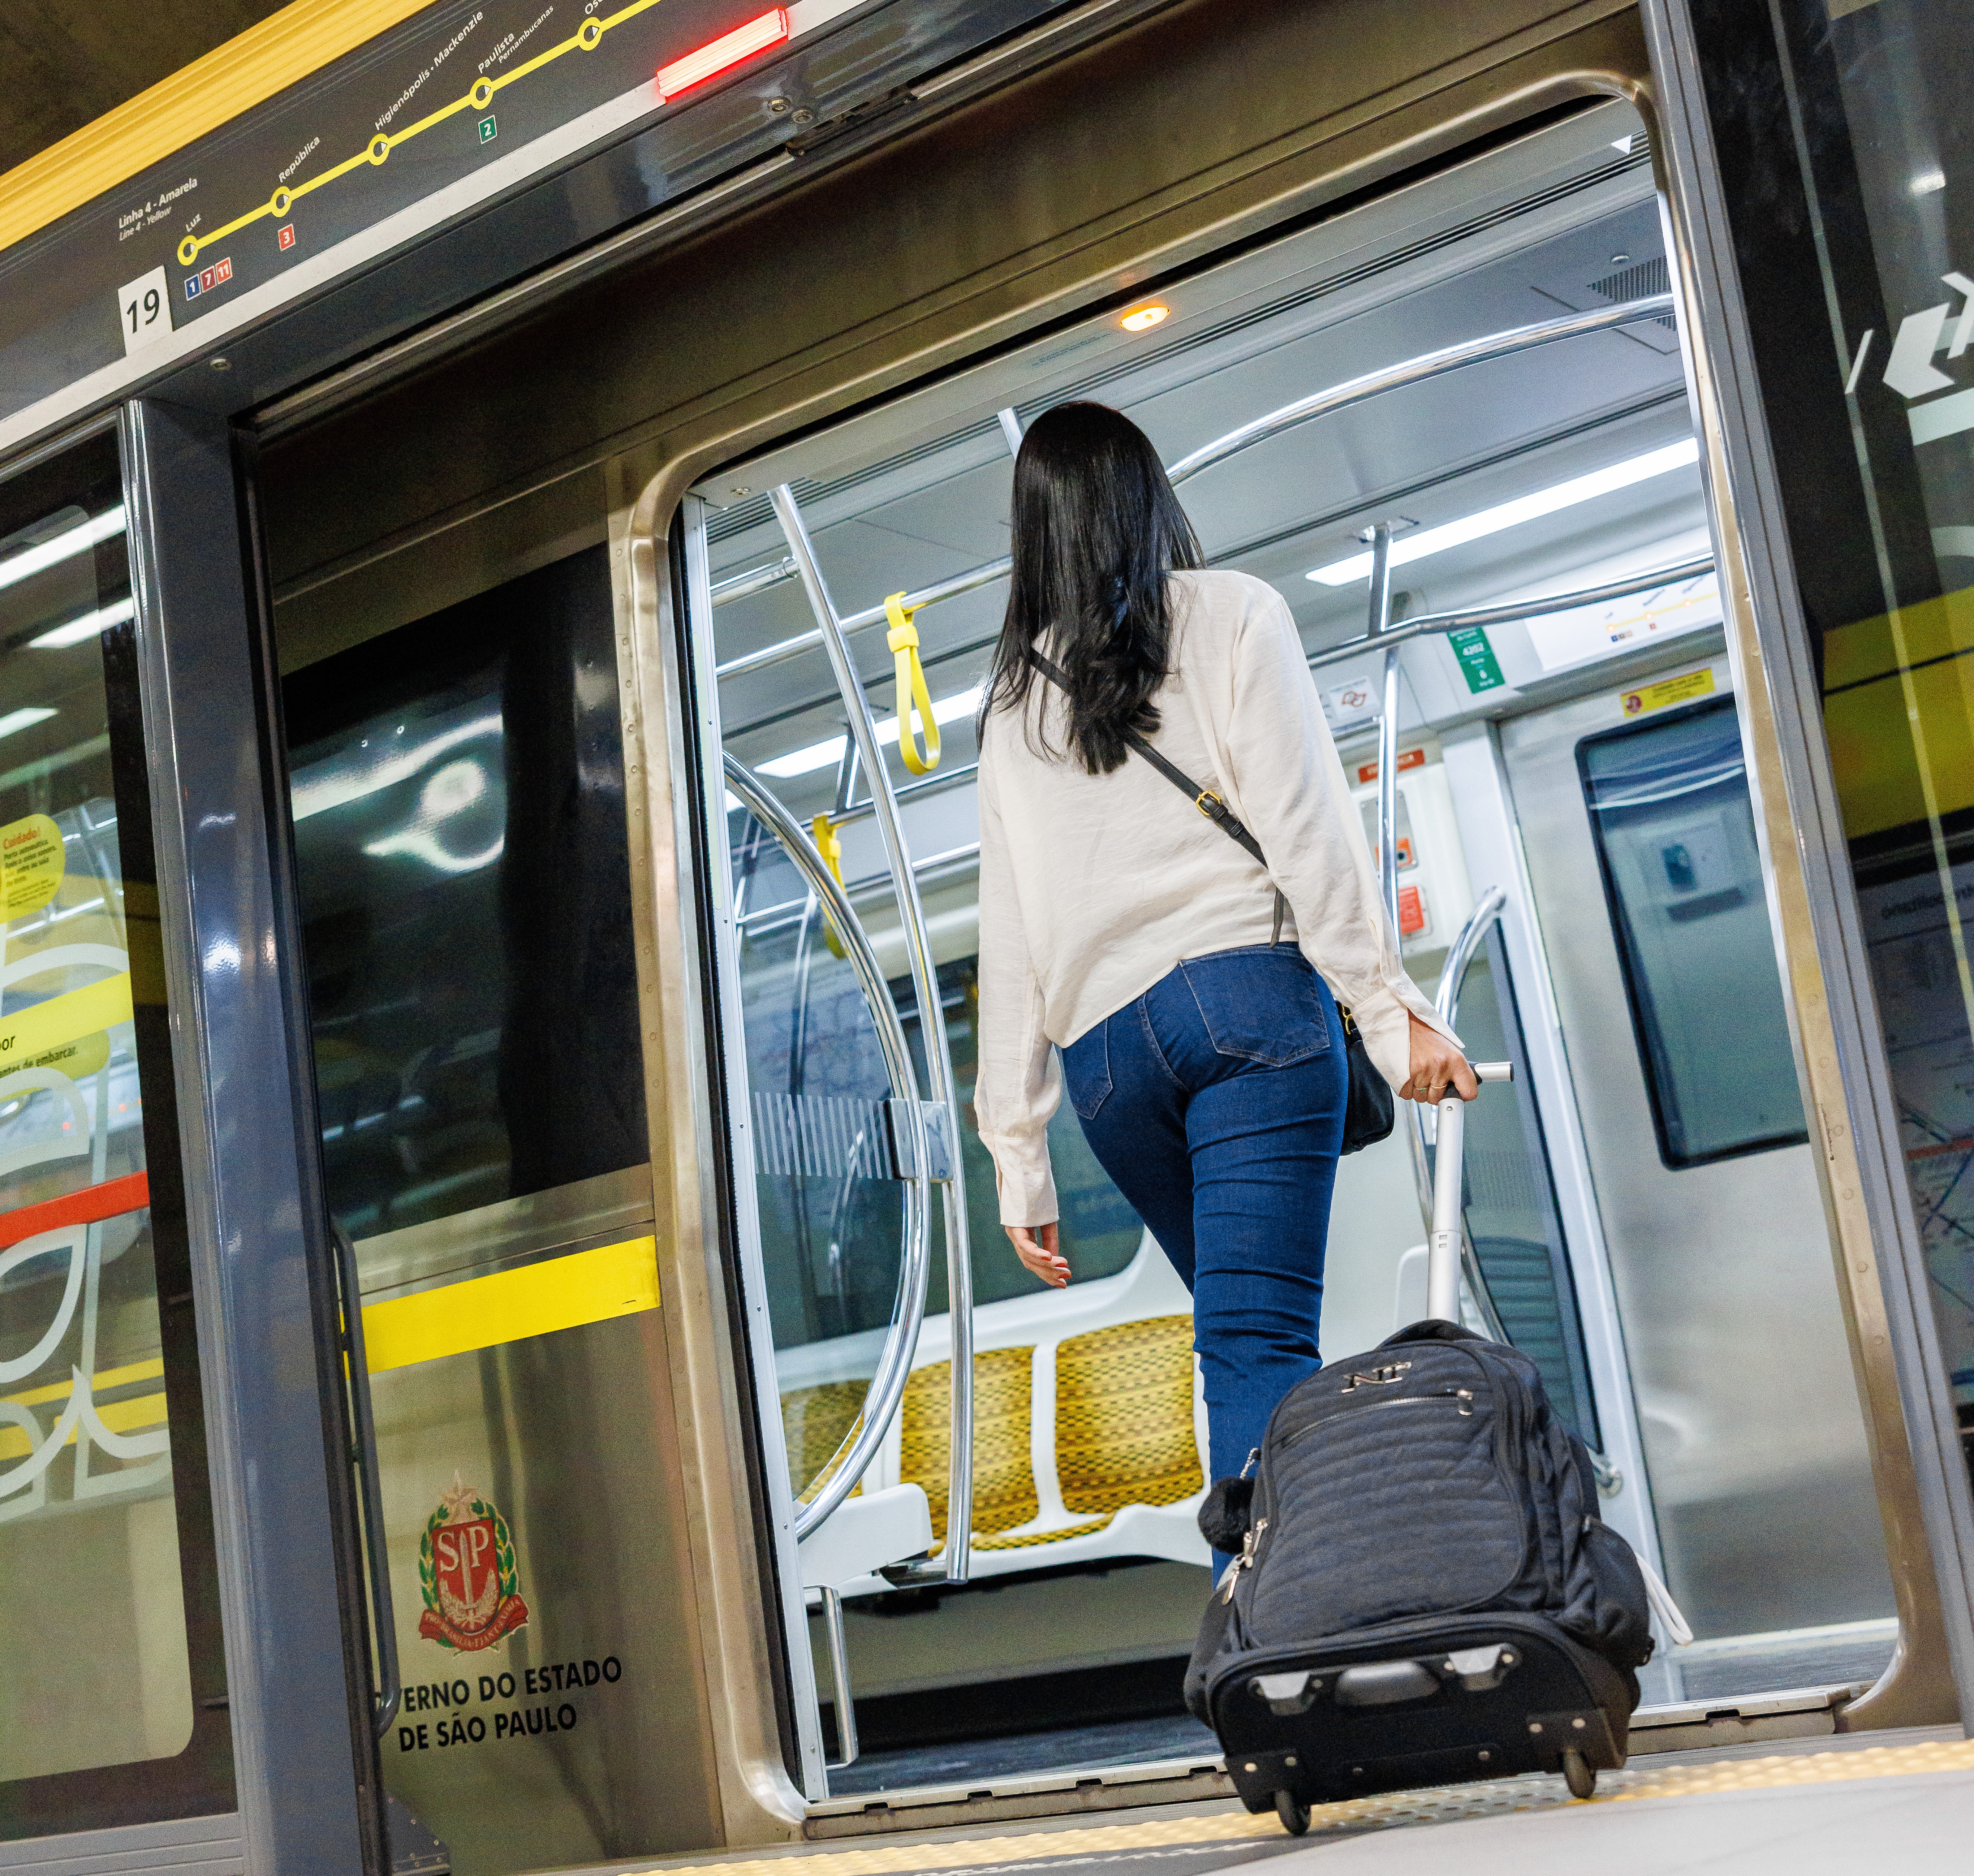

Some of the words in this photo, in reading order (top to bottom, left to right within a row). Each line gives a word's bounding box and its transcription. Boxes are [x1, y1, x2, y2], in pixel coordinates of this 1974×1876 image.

[478, 33, 515, 74] Paulista
[498, 5, 553, 64] Pernambucanas
[375, 69, 430, 131] Higienópolis
[434, 11, 483, 67] Mackenzie
[484, 123, 492, 136] 2
[278, 137, 320, 183] República
[118, 208, 143, 229] Linha
[145, 202, 151, 213] 4
[159, 177, 198, 207] Amarela
[119, 227, 134, 241] Line
[135, 221, 141, 231] 4
[147, 206, 172, 225] Yellow
[185, 213, 201, 232] Luz
[284, 232, 290, 244] 3
[189, 281, 195, 293] 1
[205, 273, 211, 286] 7
[218, 264, 229, 278] 11
[126, 289, 159, 334] 19
[0, 1035, 16, 1051] or
[437, 1526, 490, 1573] SP
[399, 1679, 470, 1712] ERNO
[478, 1671, 516, 1702] DO
[525, 1656, 622, 1695] ESTADO
[398, 1723, 429, 1752] DE
[436, 1711, 486, 1747] SÃO
[495, 1703, 577, 1739] PAULO
